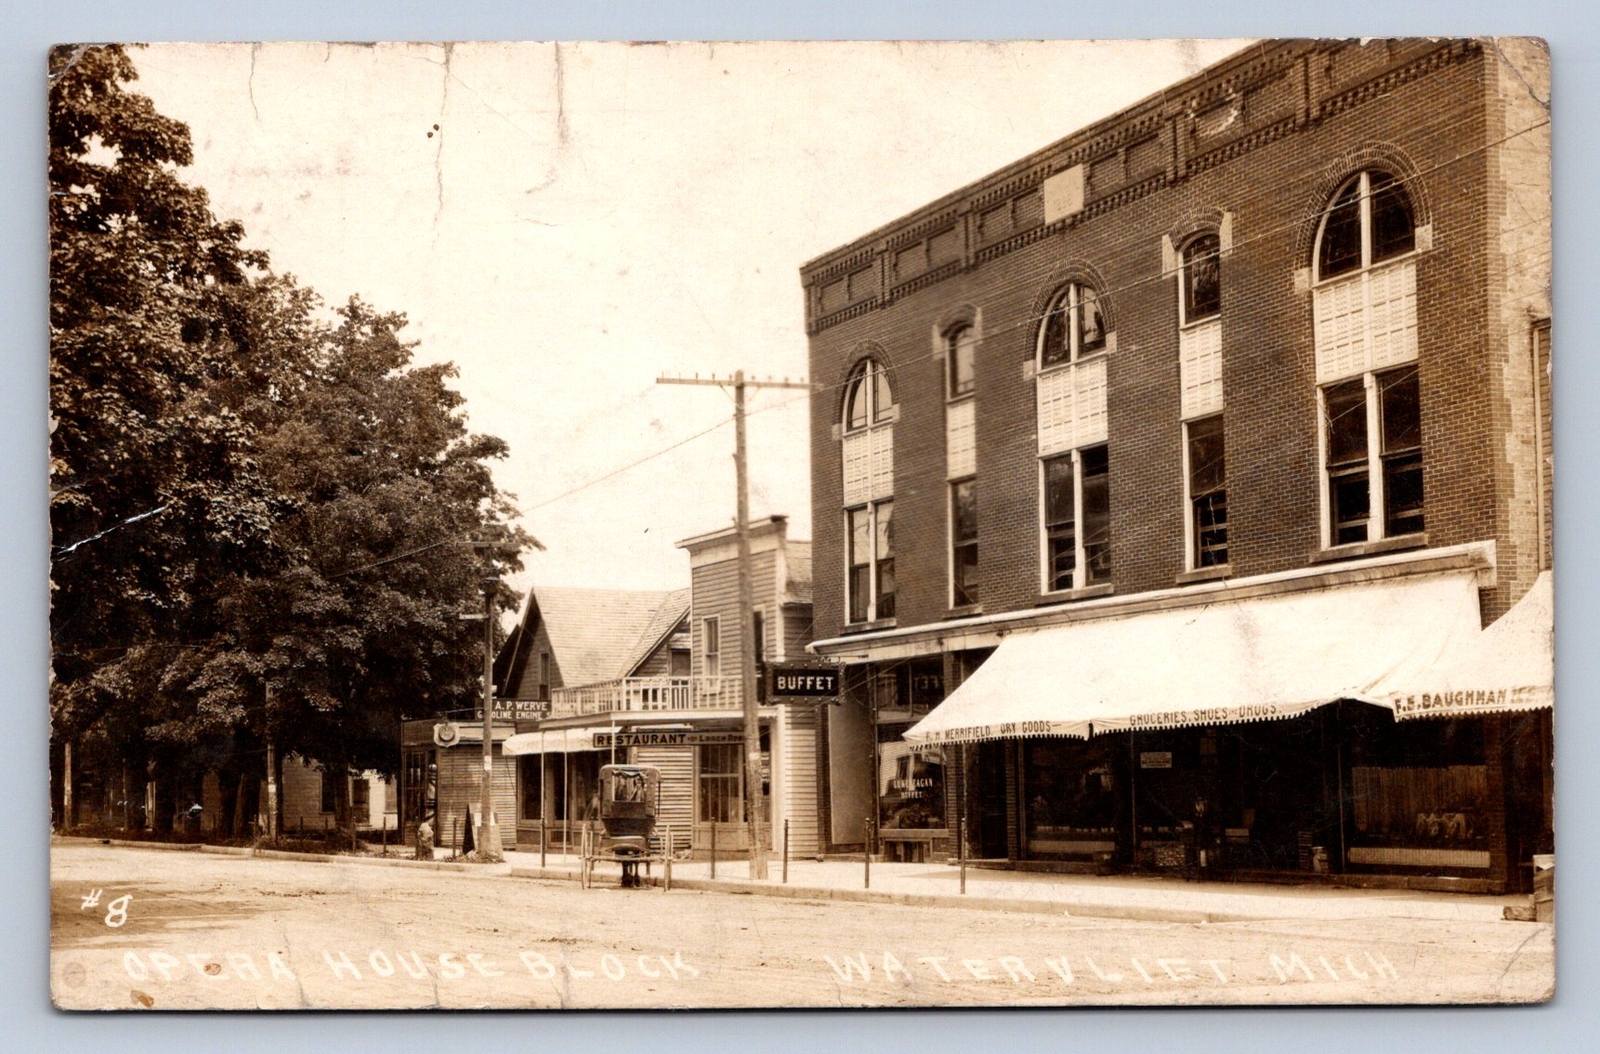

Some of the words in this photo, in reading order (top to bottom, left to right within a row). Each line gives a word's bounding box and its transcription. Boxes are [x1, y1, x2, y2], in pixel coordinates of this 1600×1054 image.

[777, 676, 834, 690] BUFFET
[1422, 688, 1507, 709] BAUGHMAN
[515, 701, 548, 711] WERVE
[477, 711, 513, 719] GOLINE
[1193, 707, 1228, 721] SHOES
[1000, 722, 1016, 735] DRY
[597, 734, 686, 745] RESTAURANT
